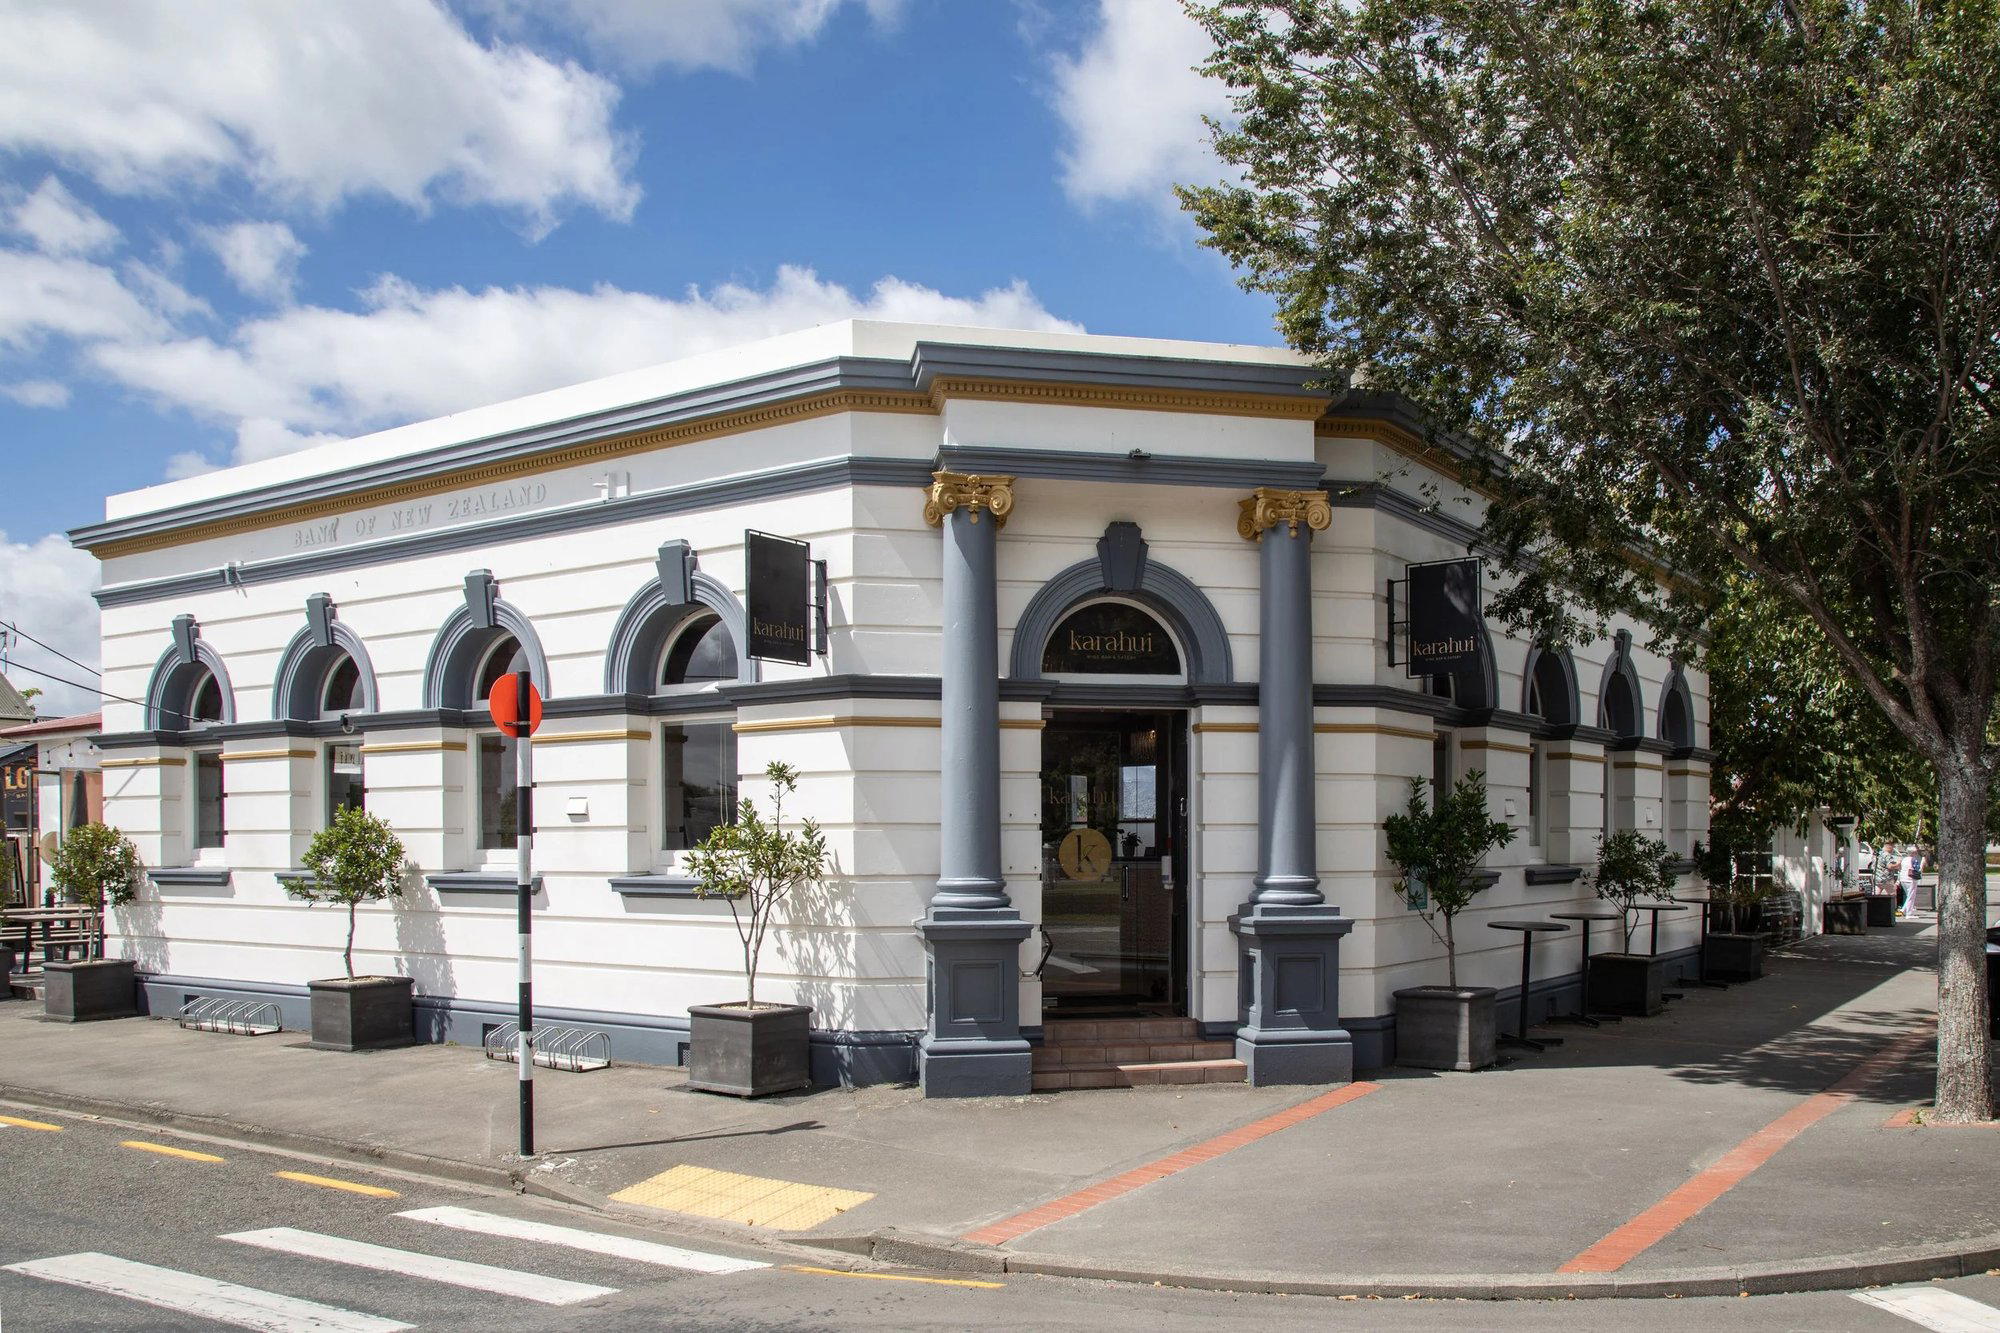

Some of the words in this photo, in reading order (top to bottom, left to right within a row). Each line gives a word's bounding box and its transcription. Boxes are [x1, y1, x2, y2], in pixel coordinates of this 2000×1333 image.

[355, 515, 377, 537] OF
[391, 504, 432, 531] NEW
[448, 483, 547, 520] ZEALAND
[753, 616, 804, 642] karahui
[1069, 629, 1153, 652] karahui
[1413, 635, 1475, 656] karahui
[1075, 834, 1099, 873] k
